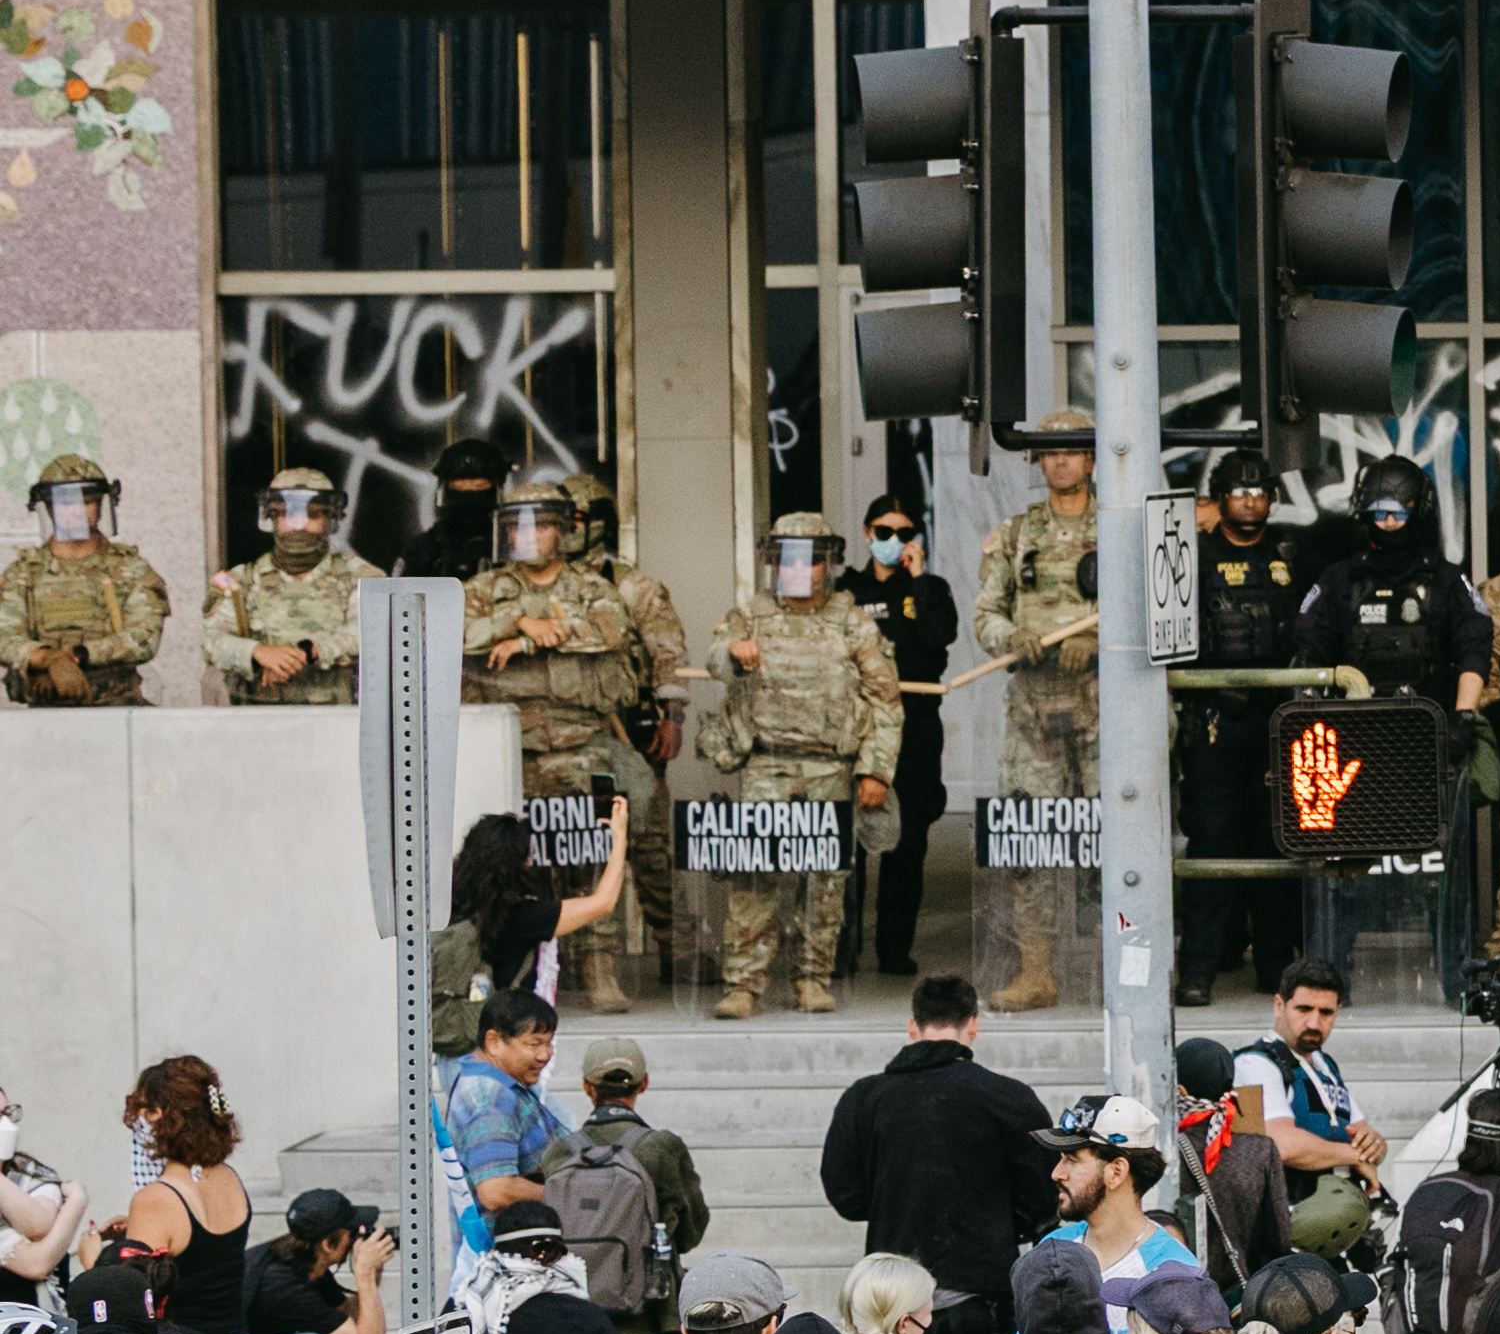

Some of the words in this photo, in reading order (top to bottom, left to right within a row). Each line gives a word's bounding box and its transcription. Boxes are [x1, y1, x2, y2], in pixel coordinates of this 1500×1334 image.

[222, 299, 580, 471] FUCK
[687, 801, 840, 837] CALIFORNIA
[987, 797, 1102, 833] CALIFORN
[687, 837, 774, 873] NATIONAL
[778, 837, 841, 873] GUARD
[987, 833, 1076, 868] NATIONAL
